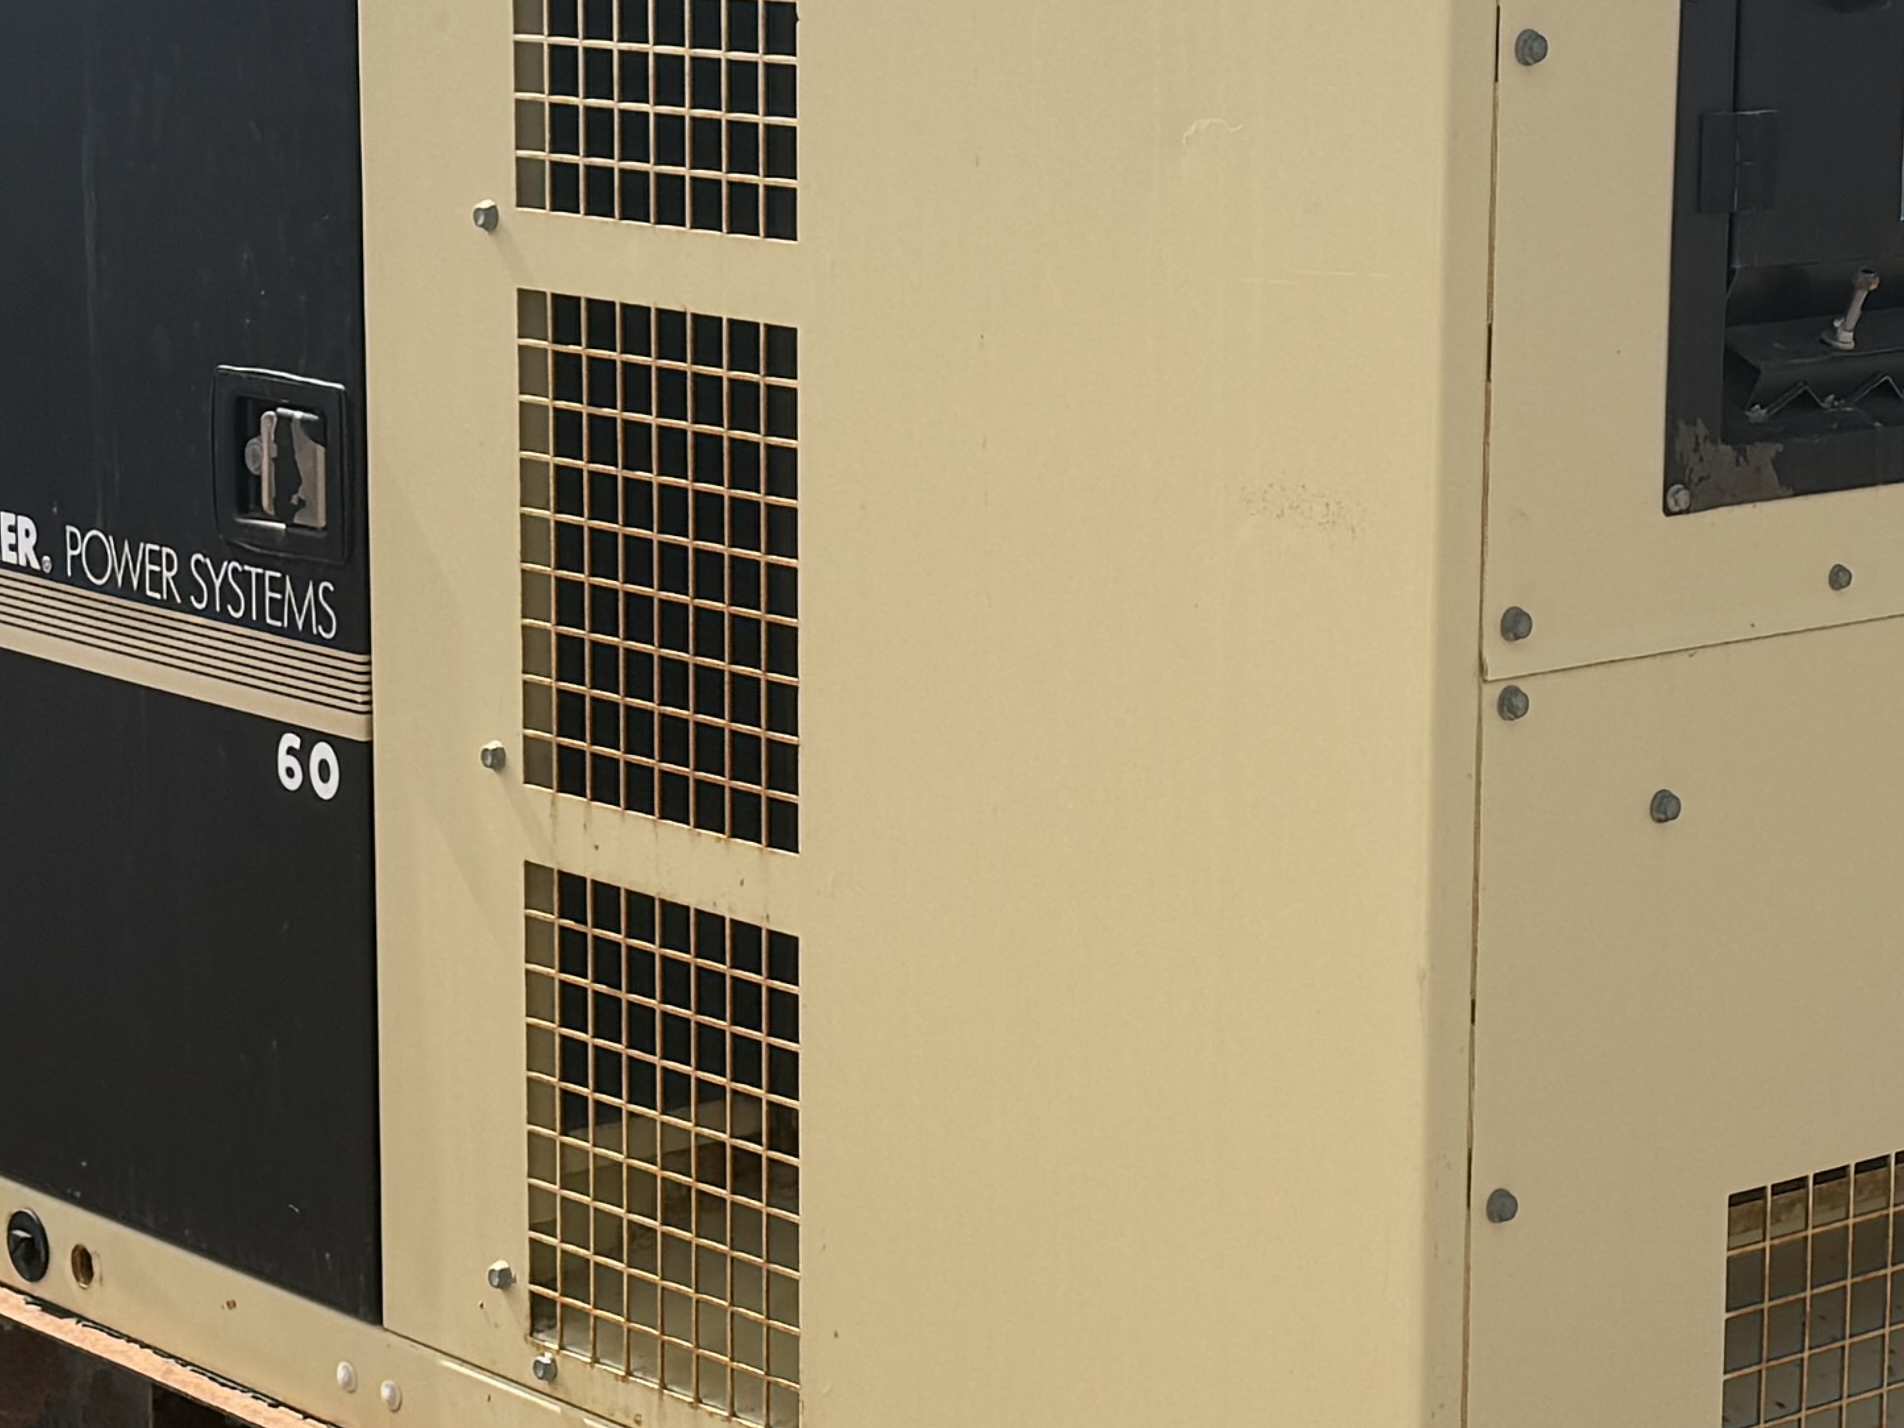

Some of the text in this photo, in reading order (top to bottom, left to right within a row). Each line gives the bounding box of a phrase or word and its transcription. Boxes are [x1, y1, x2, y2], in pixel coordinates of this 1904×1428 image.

[65, 525, 181, 604] POWER
[190, 553, 337, 640] SYSTEMS
[277, 732, 341, 801] 60
